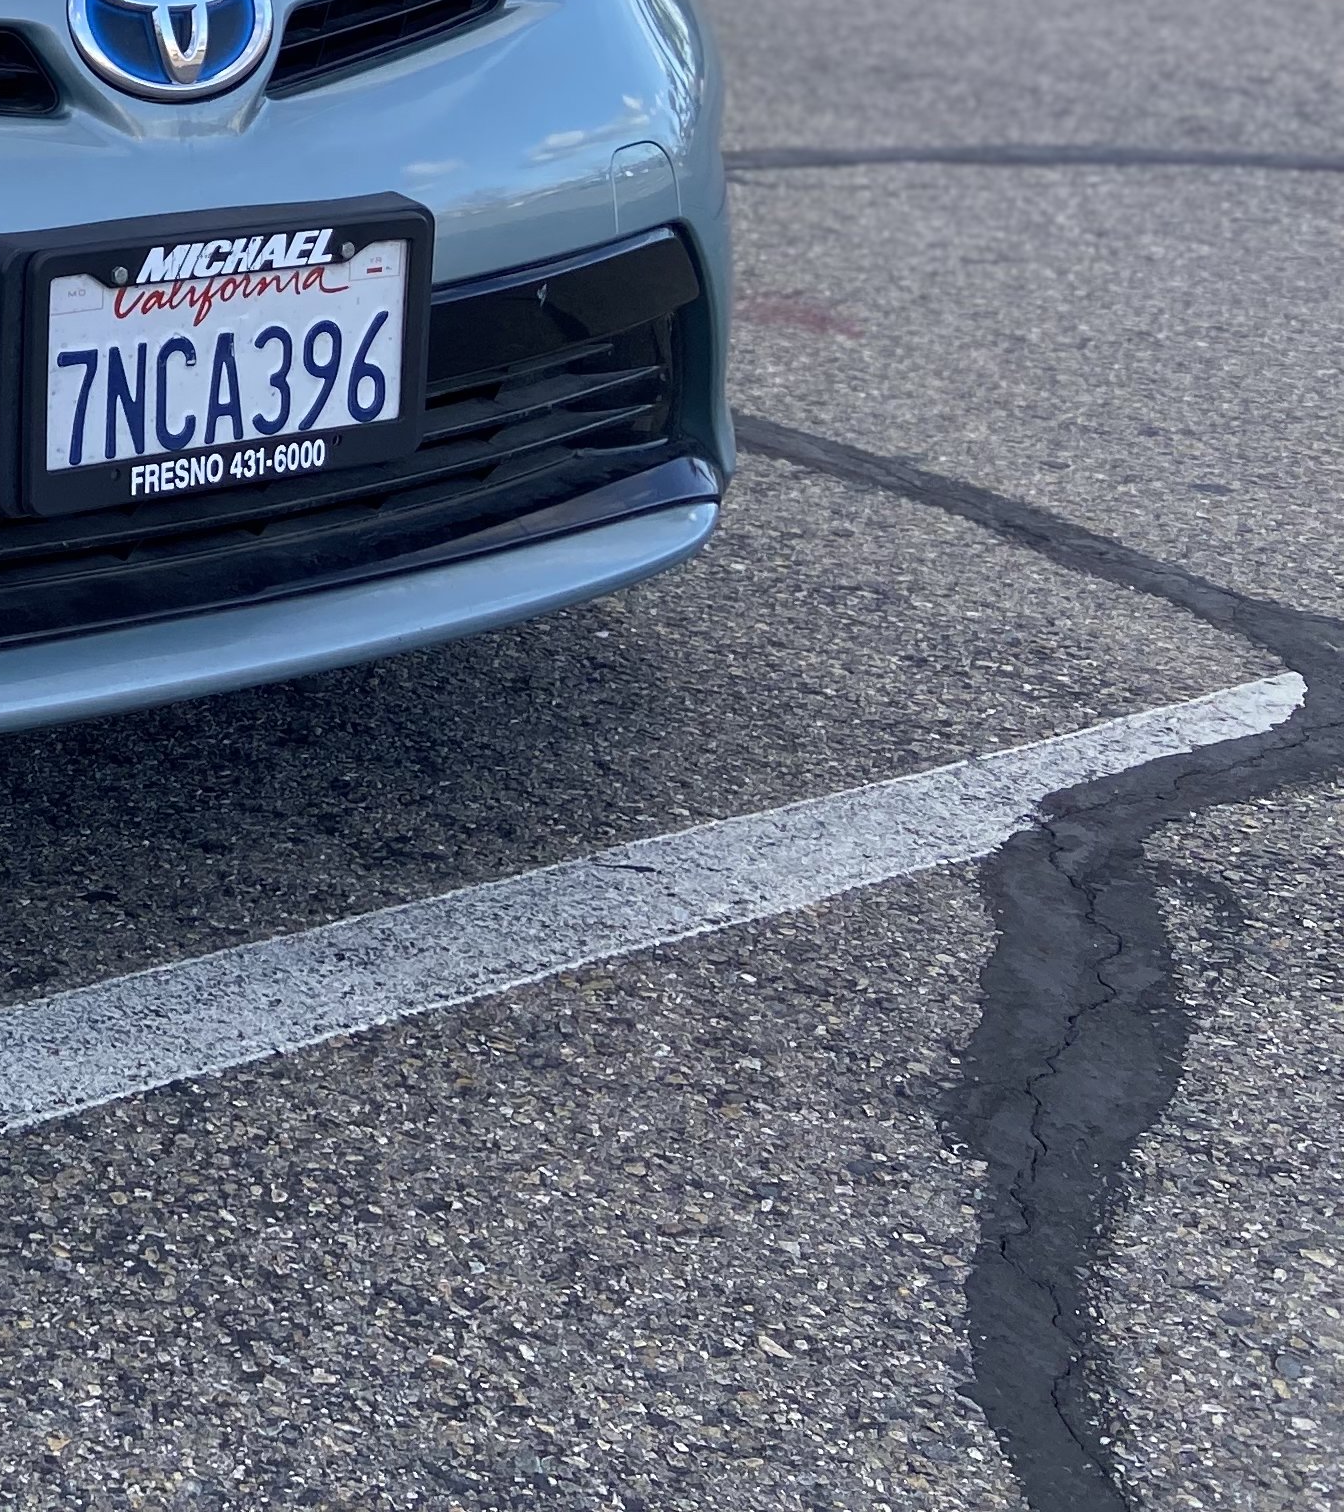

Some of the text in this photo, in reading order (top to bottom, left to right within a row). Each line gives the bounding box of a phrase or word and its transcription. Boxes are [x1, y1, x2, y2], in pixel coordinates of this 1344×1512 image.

[136, 228, 334, 284] MICHAEL
[114, 265, 350, 327] California
[56, 310, 390, 467] 7NCA396
[130, 438, 326, 496] FRESNO 431-6000
